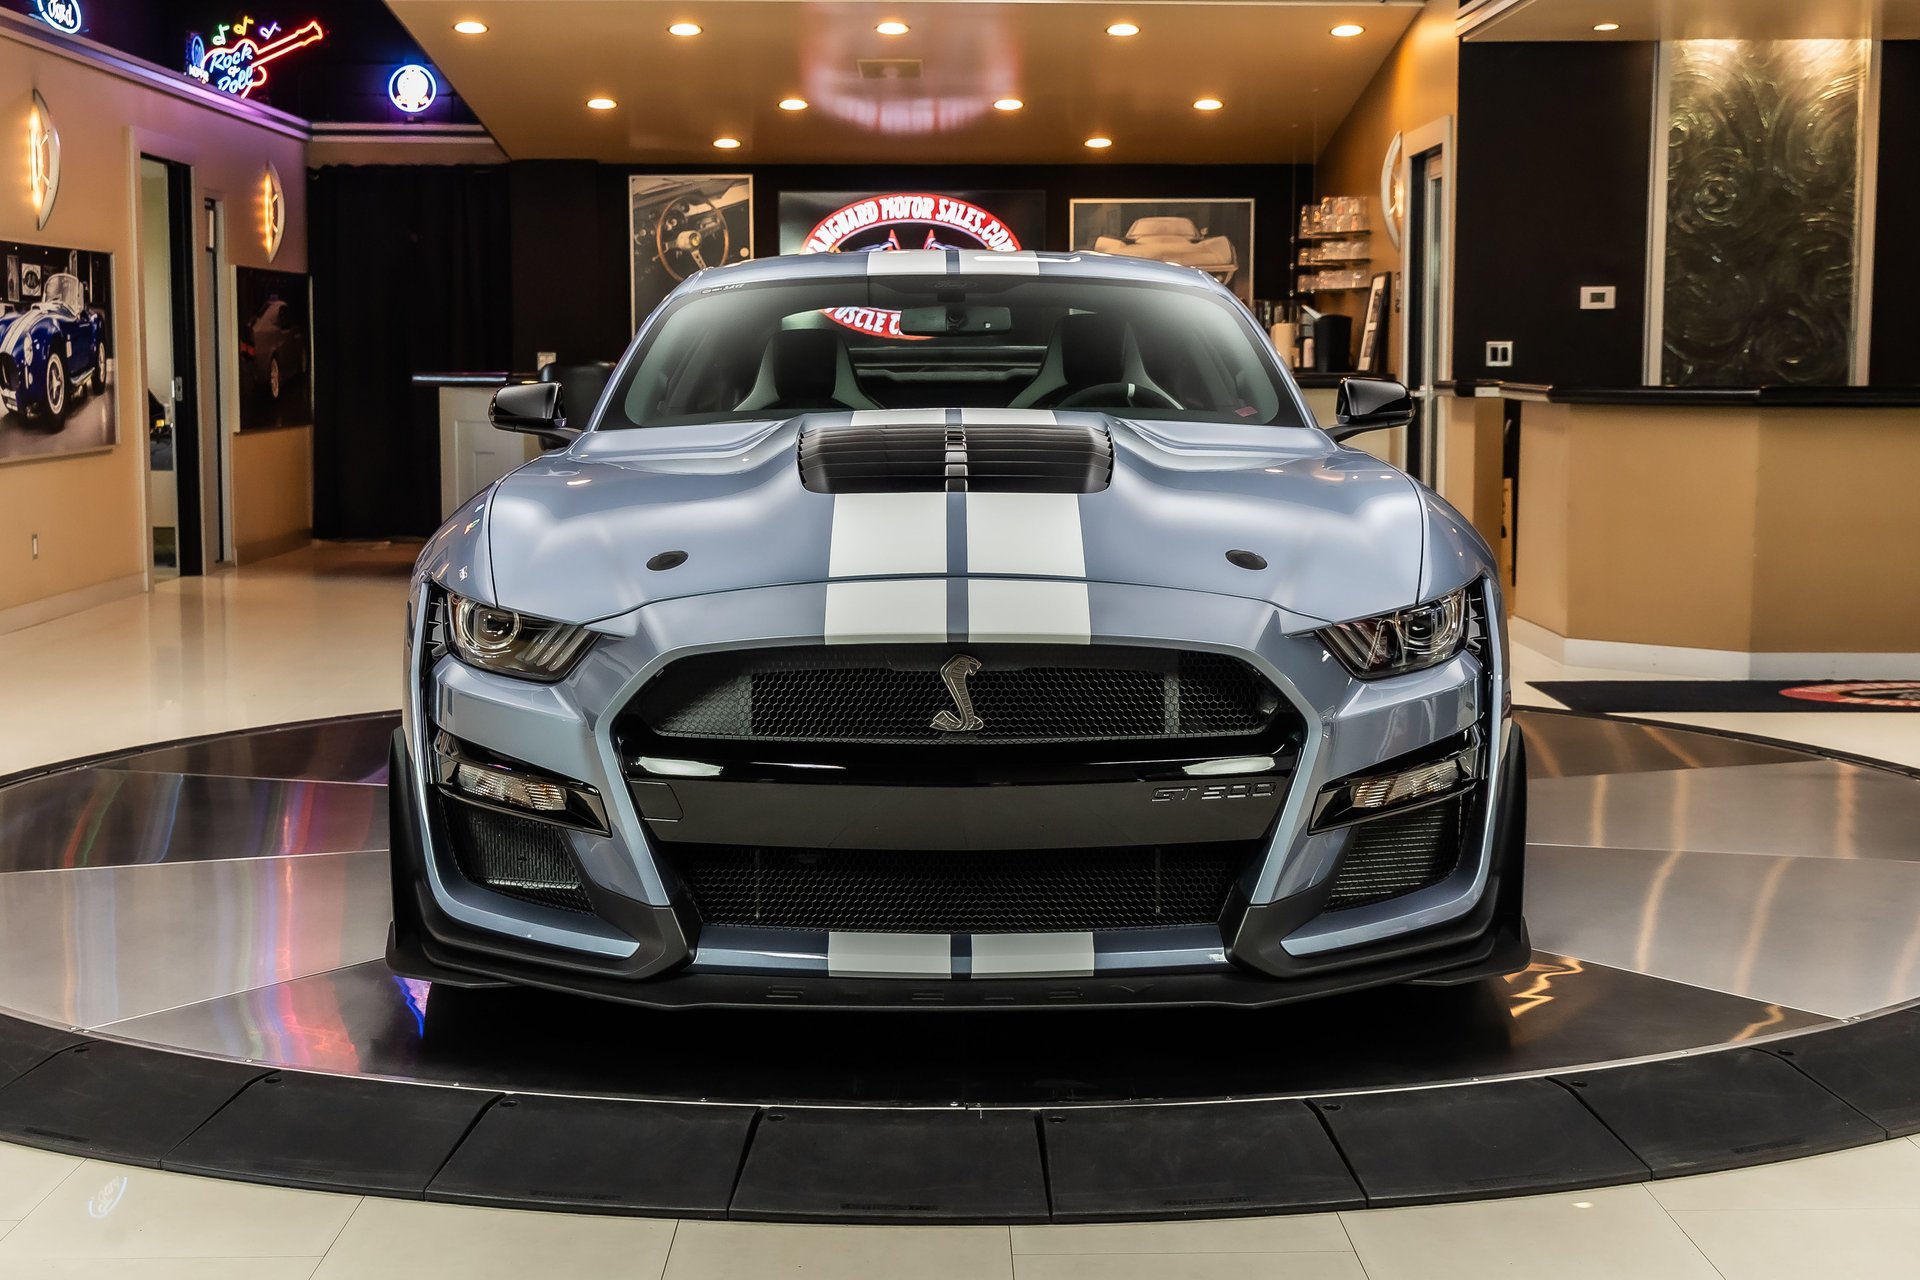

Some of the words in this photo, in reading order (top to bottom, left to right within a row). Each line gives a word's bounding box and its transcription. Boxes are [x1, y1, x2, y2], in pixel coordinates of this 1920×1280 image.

[210, 43, 253, 73] Rock
[880, 196, 935, 220] MOTOR
[825, 307, 887, 333] USCLE
[1152, 782, 1277, 801] GT500
